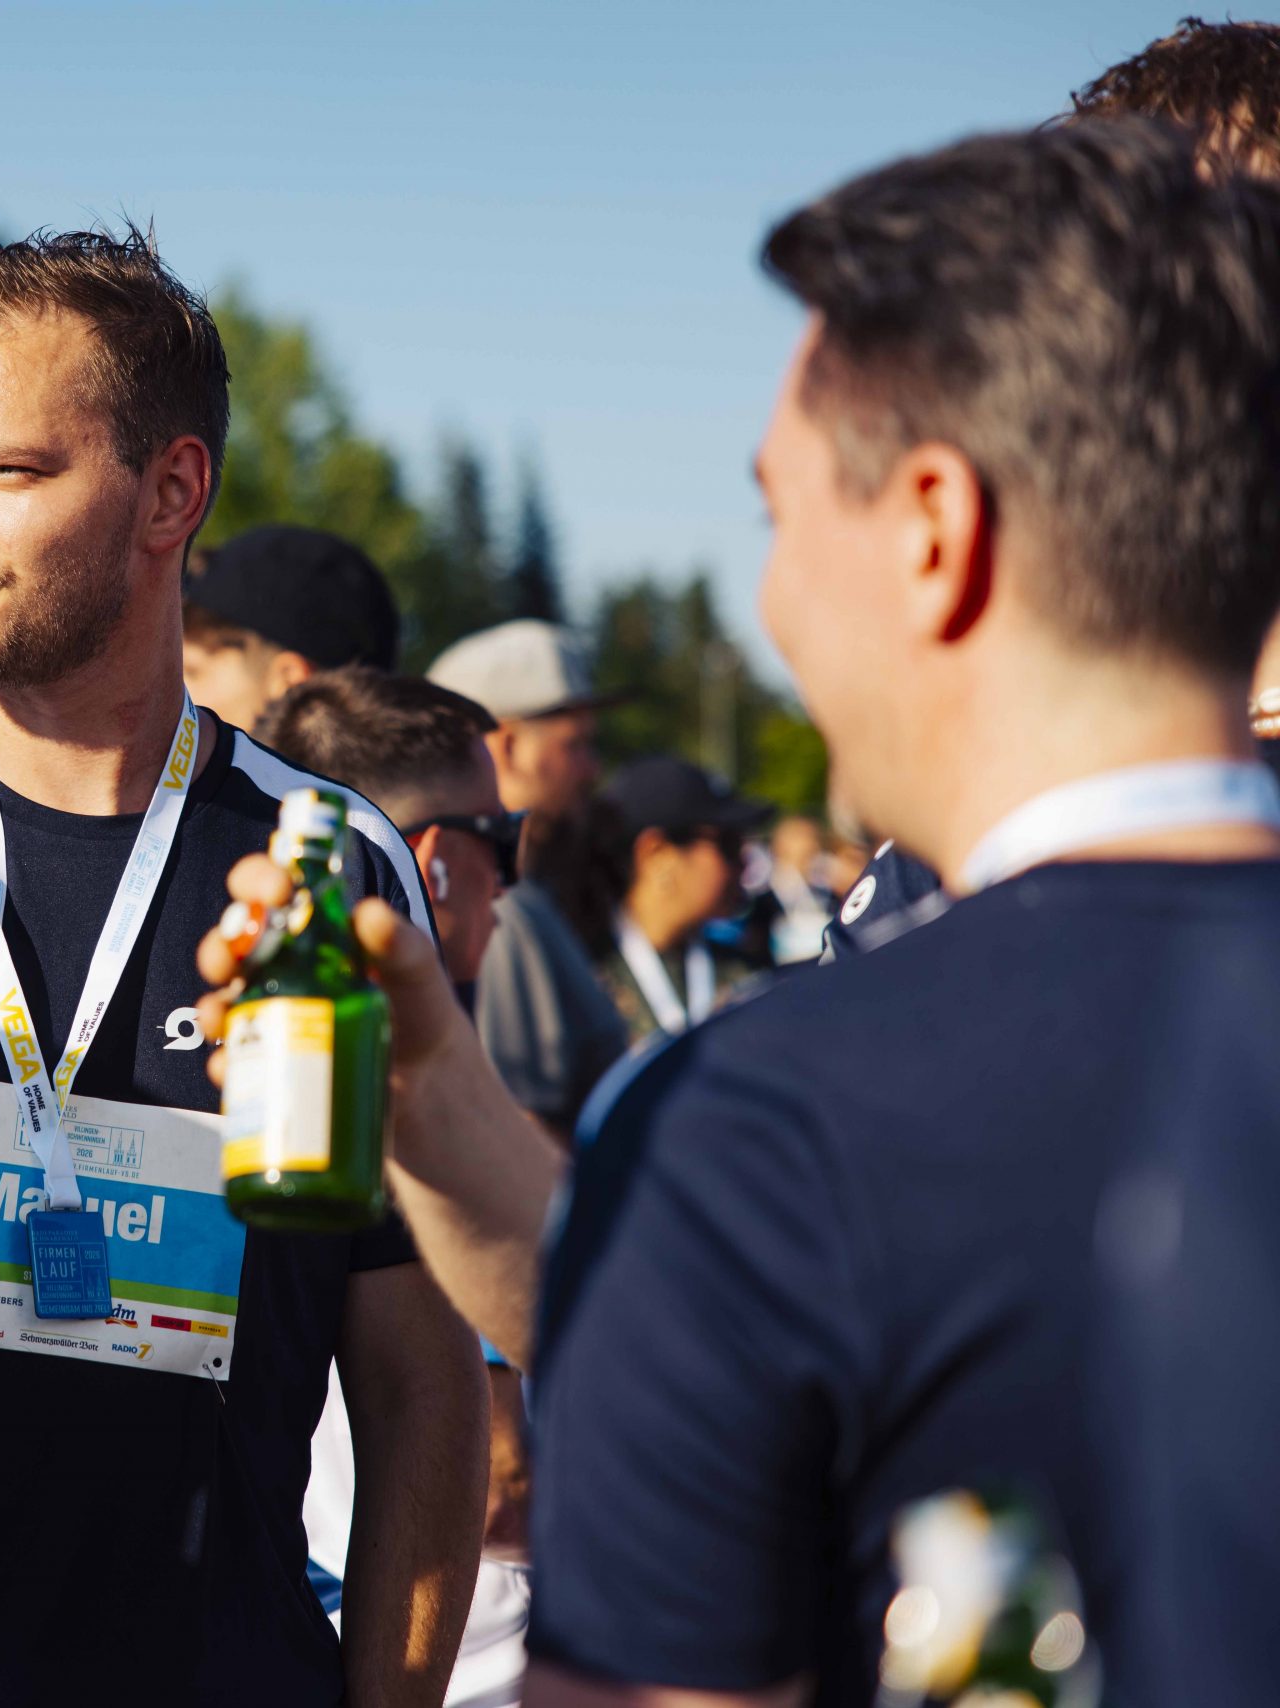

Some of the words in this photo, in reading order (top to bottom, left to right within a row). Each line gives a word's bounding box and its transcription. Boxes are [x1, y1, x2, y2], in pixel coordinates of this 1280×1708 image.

[163, 718, 196, 790] VEGA
[77, 1018, 90, 1042] HOME
[84, 1031, 91, 1042] OF
[89, 1001, 105, 1030] VALUES
[0, 986, 41, 1085] VEGA
[23, 1086, 32, 1098] OF
[32, 1084, 45, 1110] HOME
[27, 1100, 41, 1133] VALUES
[39, 1246, 76, 1259] FIRMEN
[39, 1261, 77, 1278] LAUF
[112, 1304, 136, 1320] dm
[20, 1332, 79, 1348] Schwarzwälder
[79, 1340, 99, 1352] Bote
[111, 1343, 138, 1354] RADIO
[138, 1343, 153, 1359] 7
